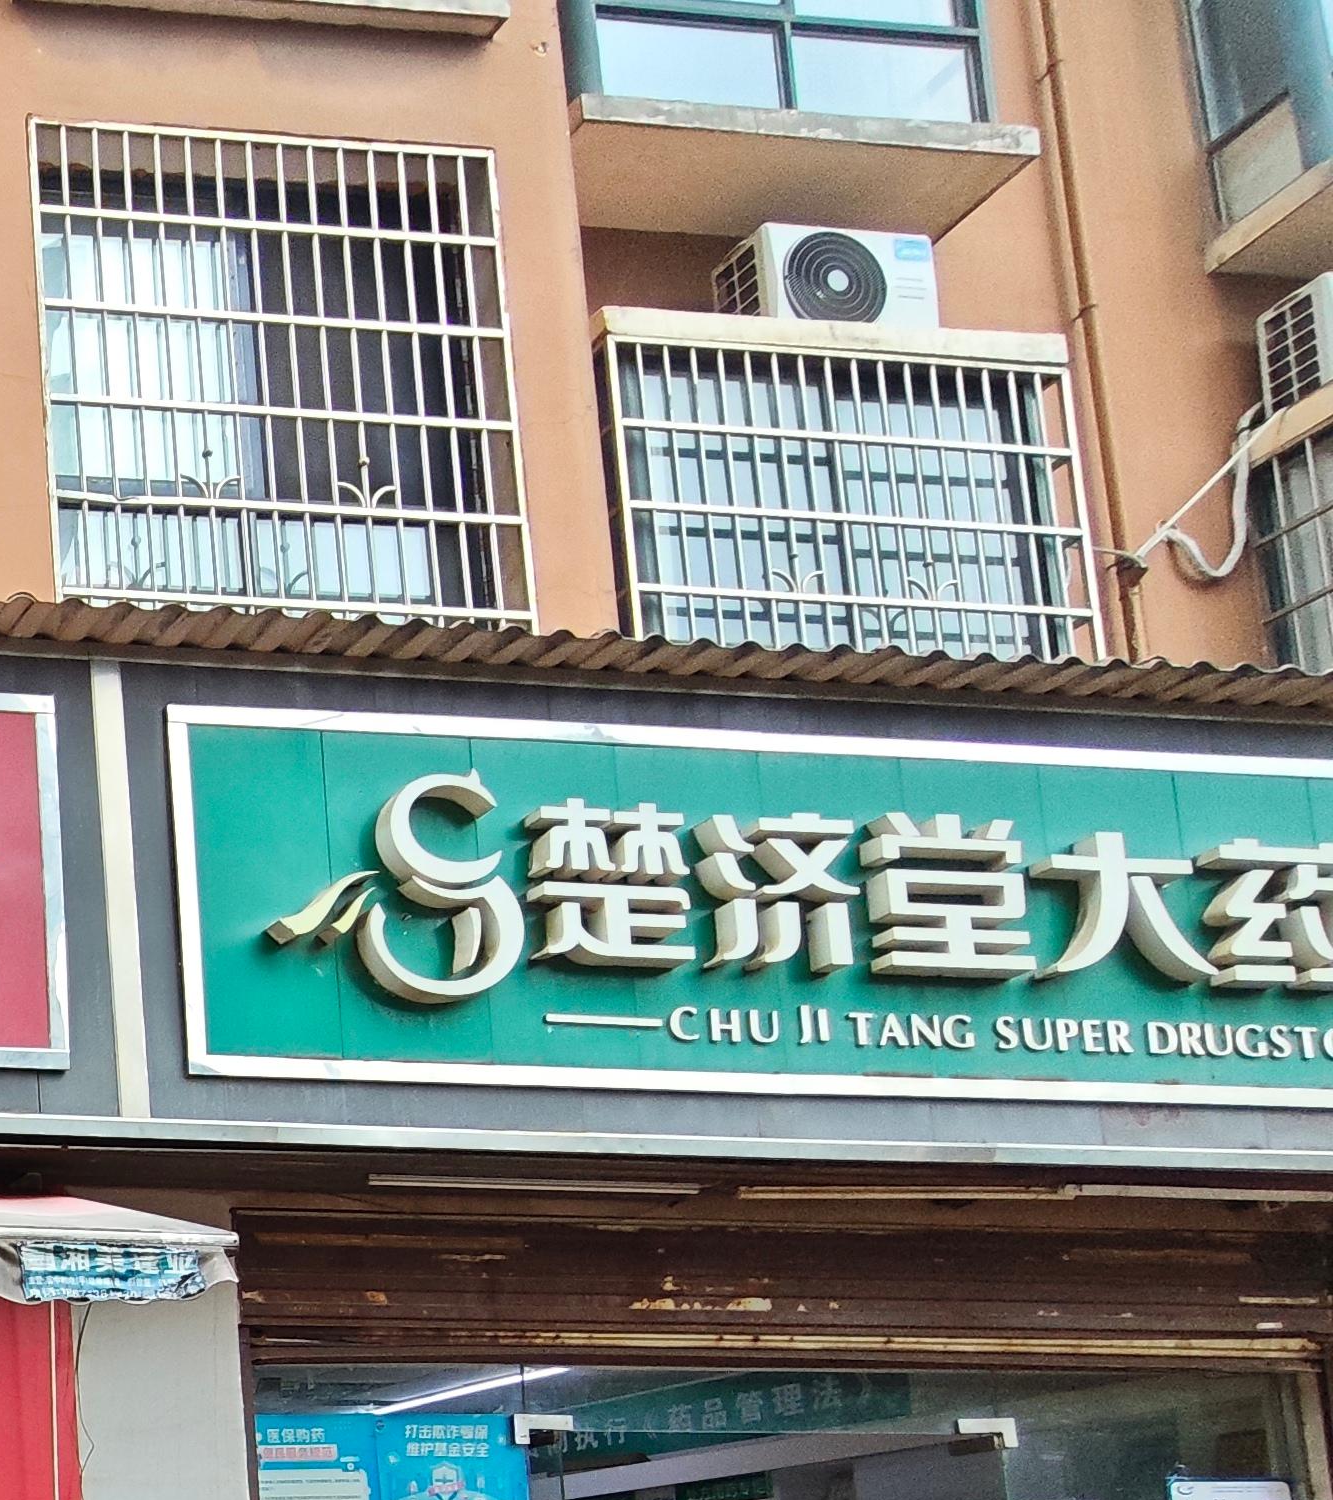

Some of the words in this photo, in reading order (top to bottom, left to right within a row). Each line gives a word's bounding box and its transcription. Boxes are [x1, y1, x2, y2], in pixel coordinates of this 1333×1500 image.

[525, 797, 1333, 990] 楚济堂大药
[668, 1006, 780, 1044] CHU
[799, 1004, 831, 1043] JI
[849, 1011, 976, 1049] TANG
[994, 1015, 1135, 1056] SUPER
